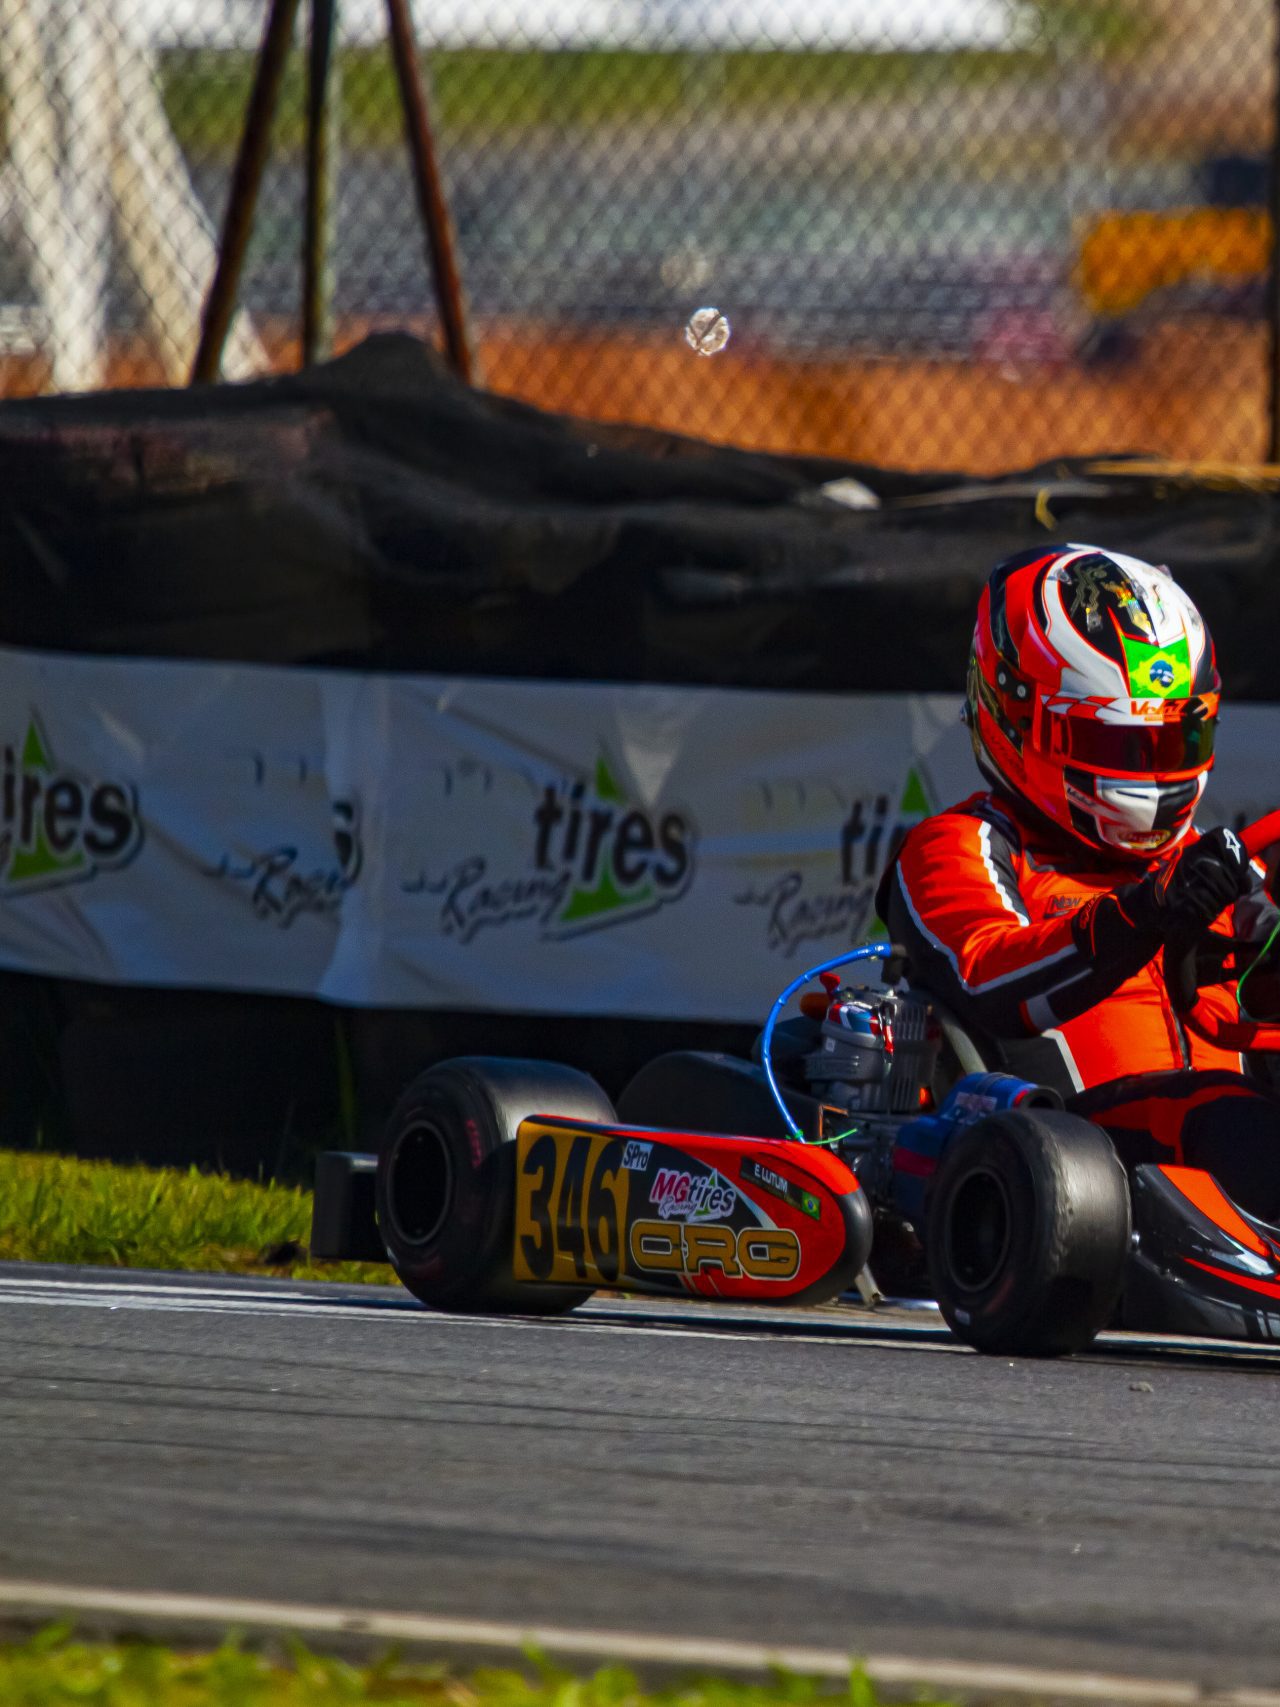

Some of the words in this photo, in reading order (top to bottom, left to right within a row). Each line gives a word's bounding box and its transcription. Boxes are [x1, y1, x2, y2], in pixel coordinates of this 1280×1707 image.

[534, 780, 688, 887] tires
[520, 1134, 621, 1281] 346
[630, 1218, 801, 1280] CRG
